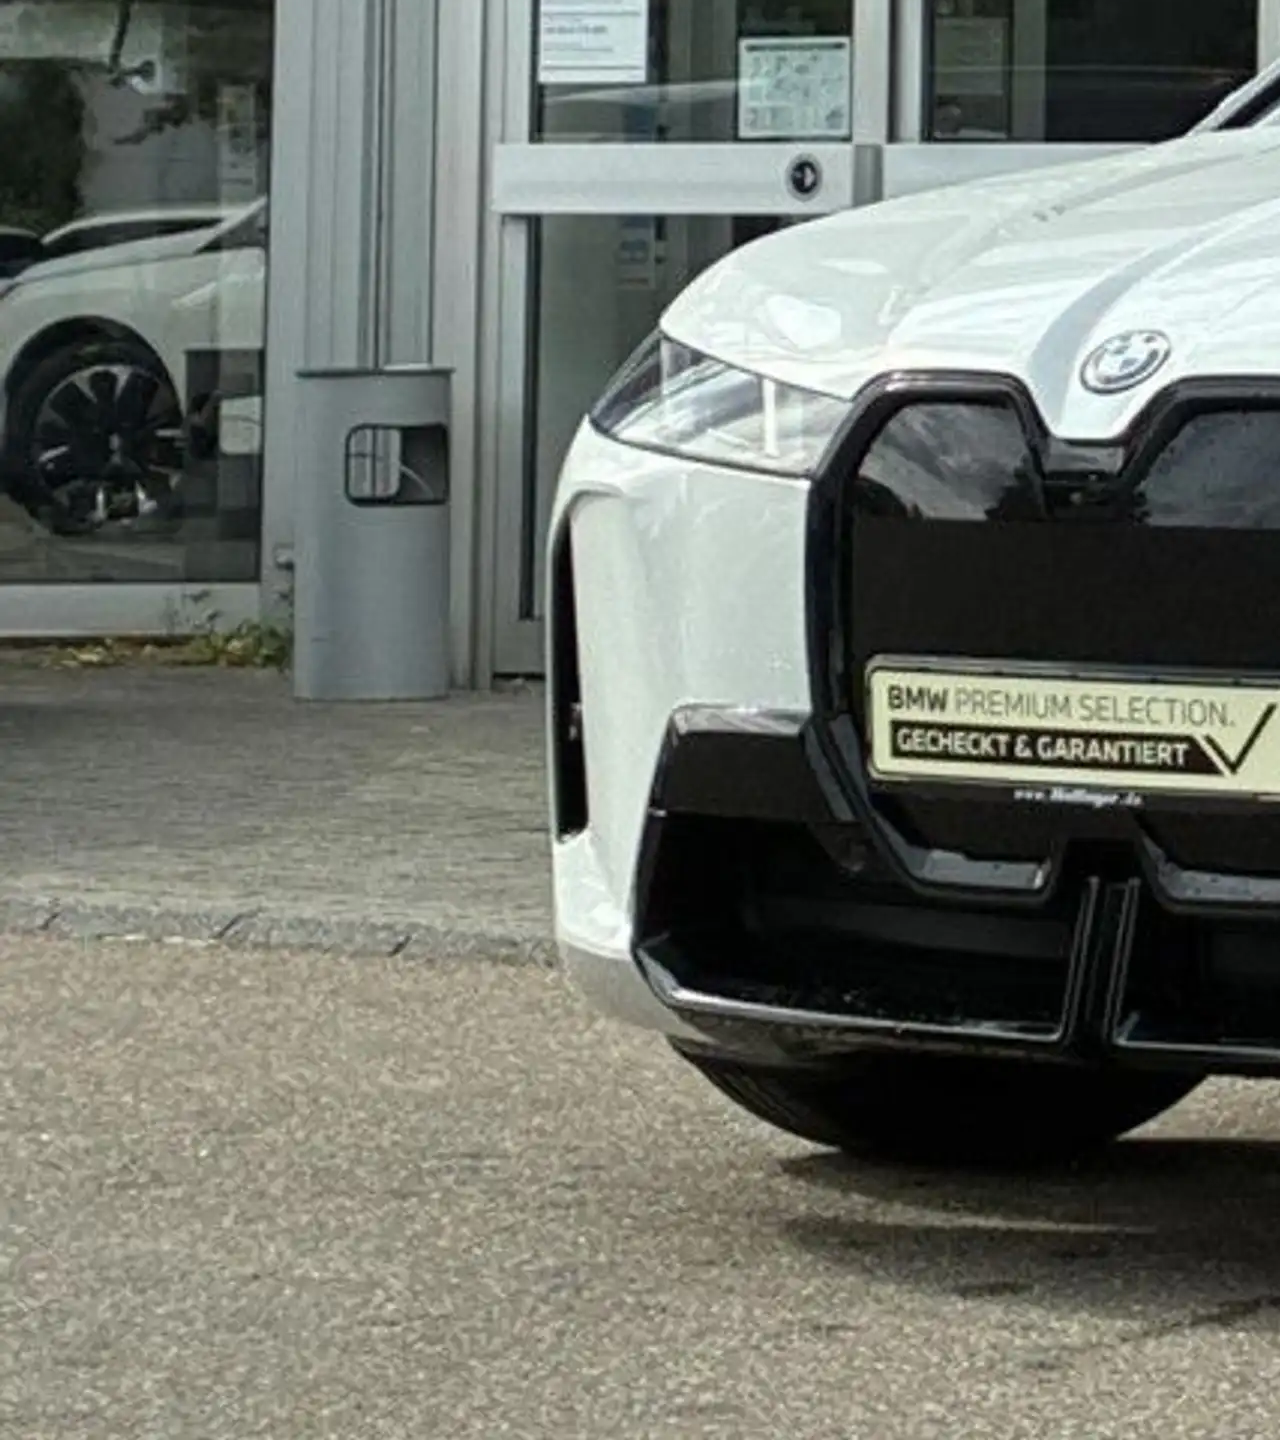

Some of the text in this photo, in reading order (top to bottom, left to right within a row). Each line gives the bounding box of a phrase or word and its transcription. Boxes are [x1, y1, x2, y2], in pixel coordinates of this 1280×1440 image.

[887, 683, 949, 712] BMW
[954, 686, 1072, 720] PREMIUM
[897, 728, 1189, 768] GECHECKT & GARANTIERT
